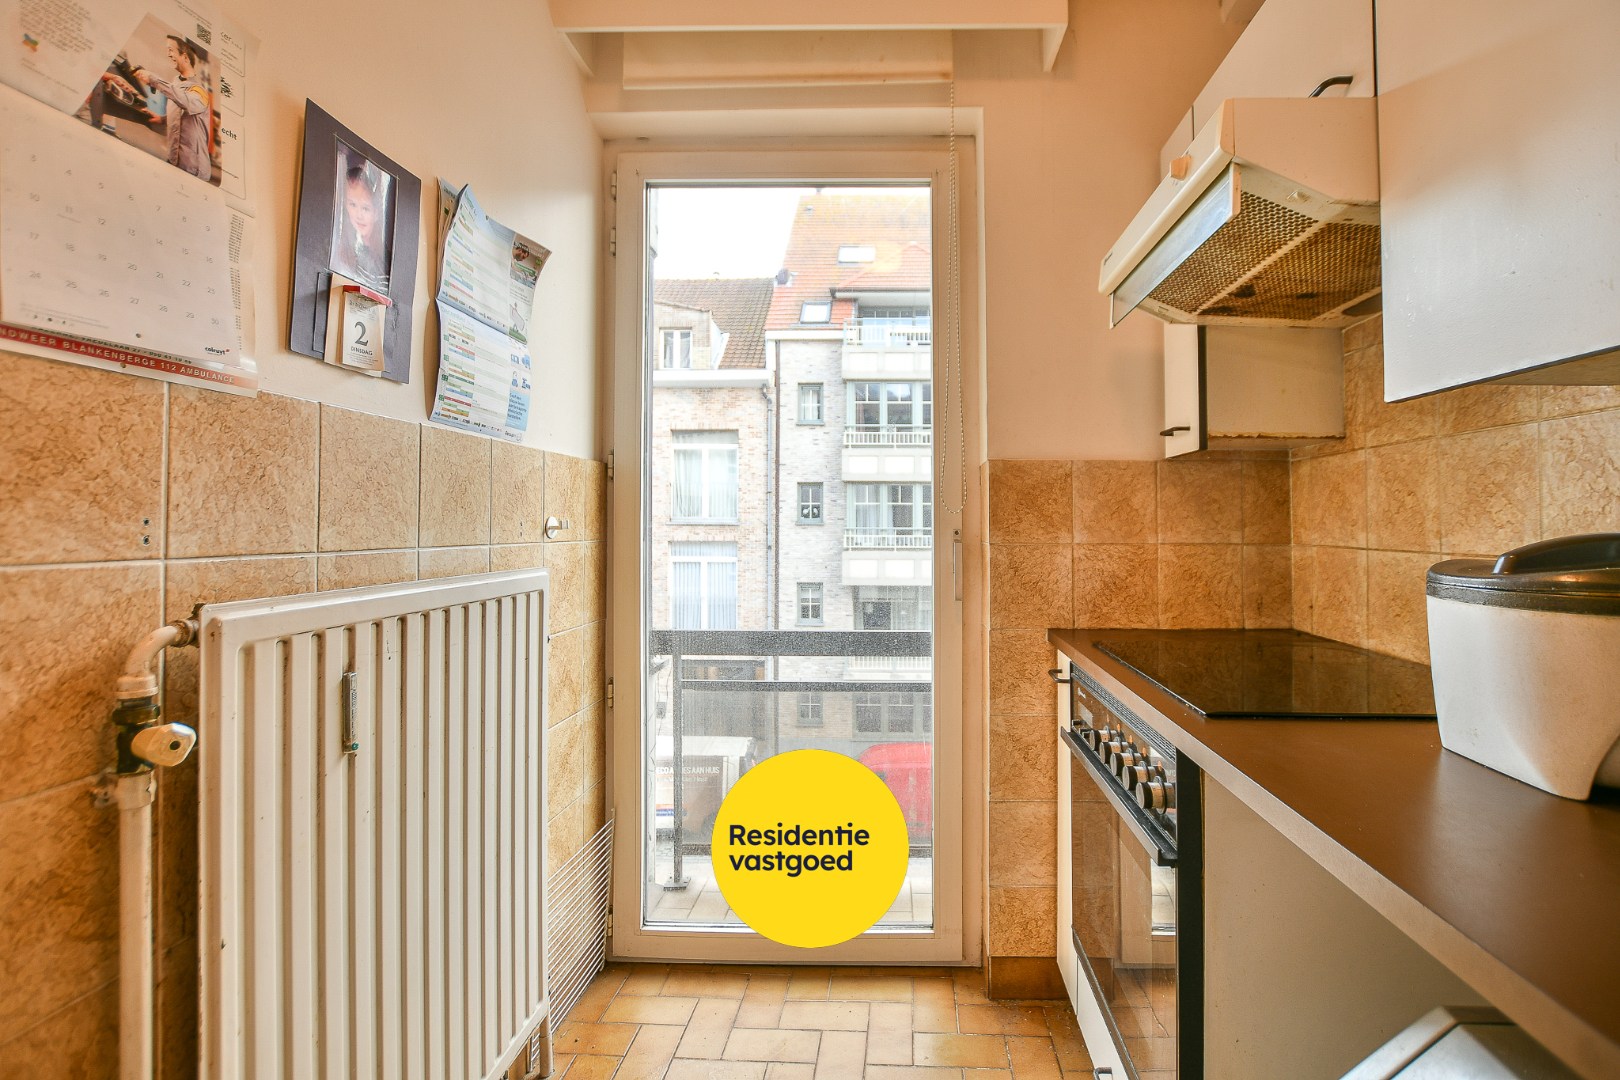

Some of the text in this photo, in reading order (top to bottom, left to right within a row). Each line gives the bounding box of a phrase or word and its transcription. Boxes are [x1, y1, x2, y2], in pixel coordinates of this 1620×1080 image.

[97, 217, 106, 226] 12
[128, 228, 136, 237] 13
[156, 238, 164, 246] 14
[206, 256, 213, 264] 16
[128, 263, 138, 271] 20
[211, 317, 220, 326] 30
[354, 321, 368, 347] 2
[350, 346, 373, 356] DINSDAG
[62, 341, 156, 366] BLANKENBERGE
[160, 362, 177, 371] 112
[180, 366, 234, 384] AMBULANCE
